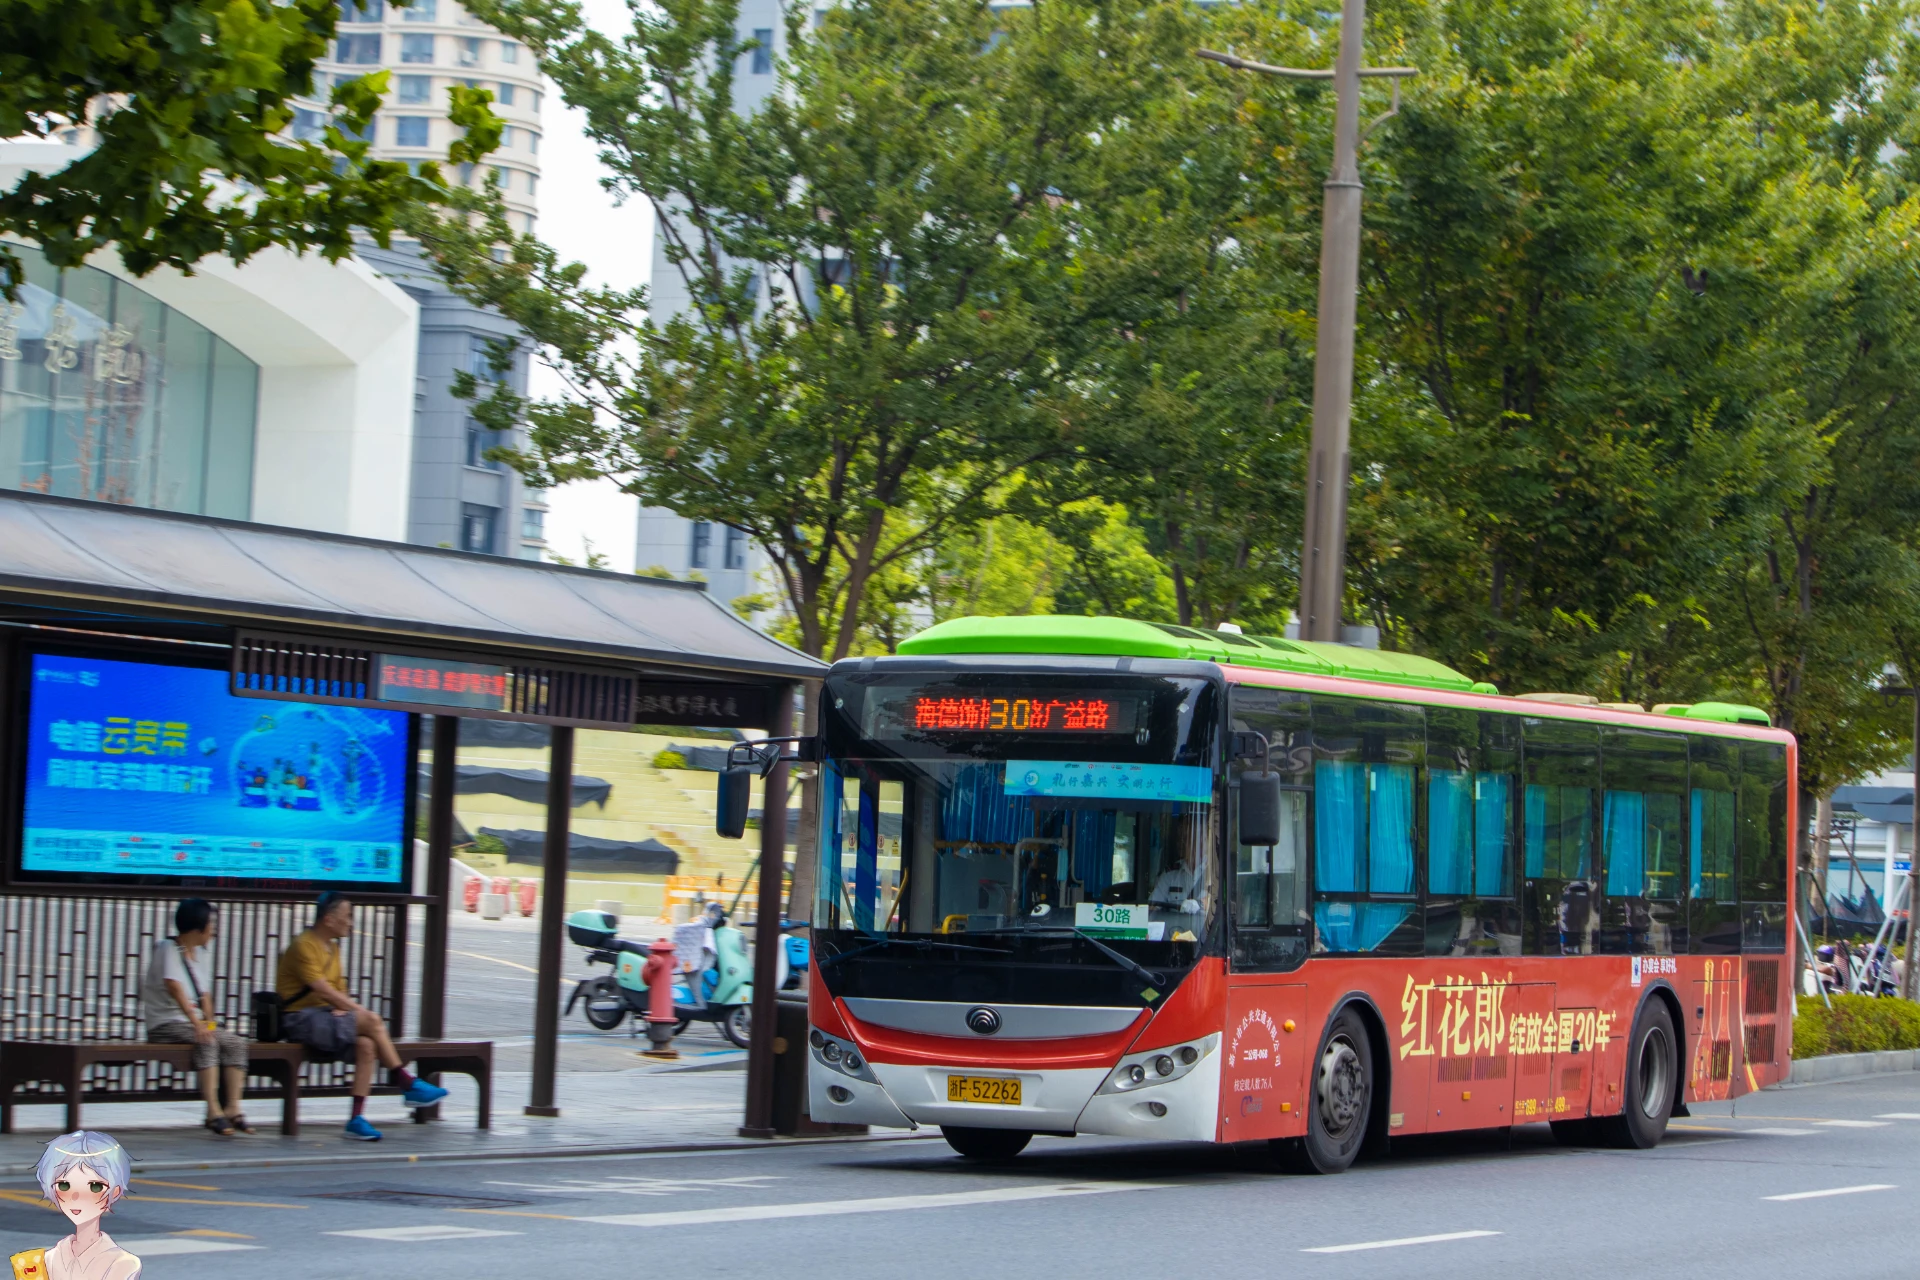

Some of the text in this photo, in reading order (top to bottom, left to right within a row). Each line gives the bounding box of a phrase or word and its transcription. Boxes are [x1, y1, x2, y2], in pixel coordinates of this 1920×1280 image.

[1093, 908, 1131, 925] 30路
[1399, 971, 1506, 1062] 红花郎
